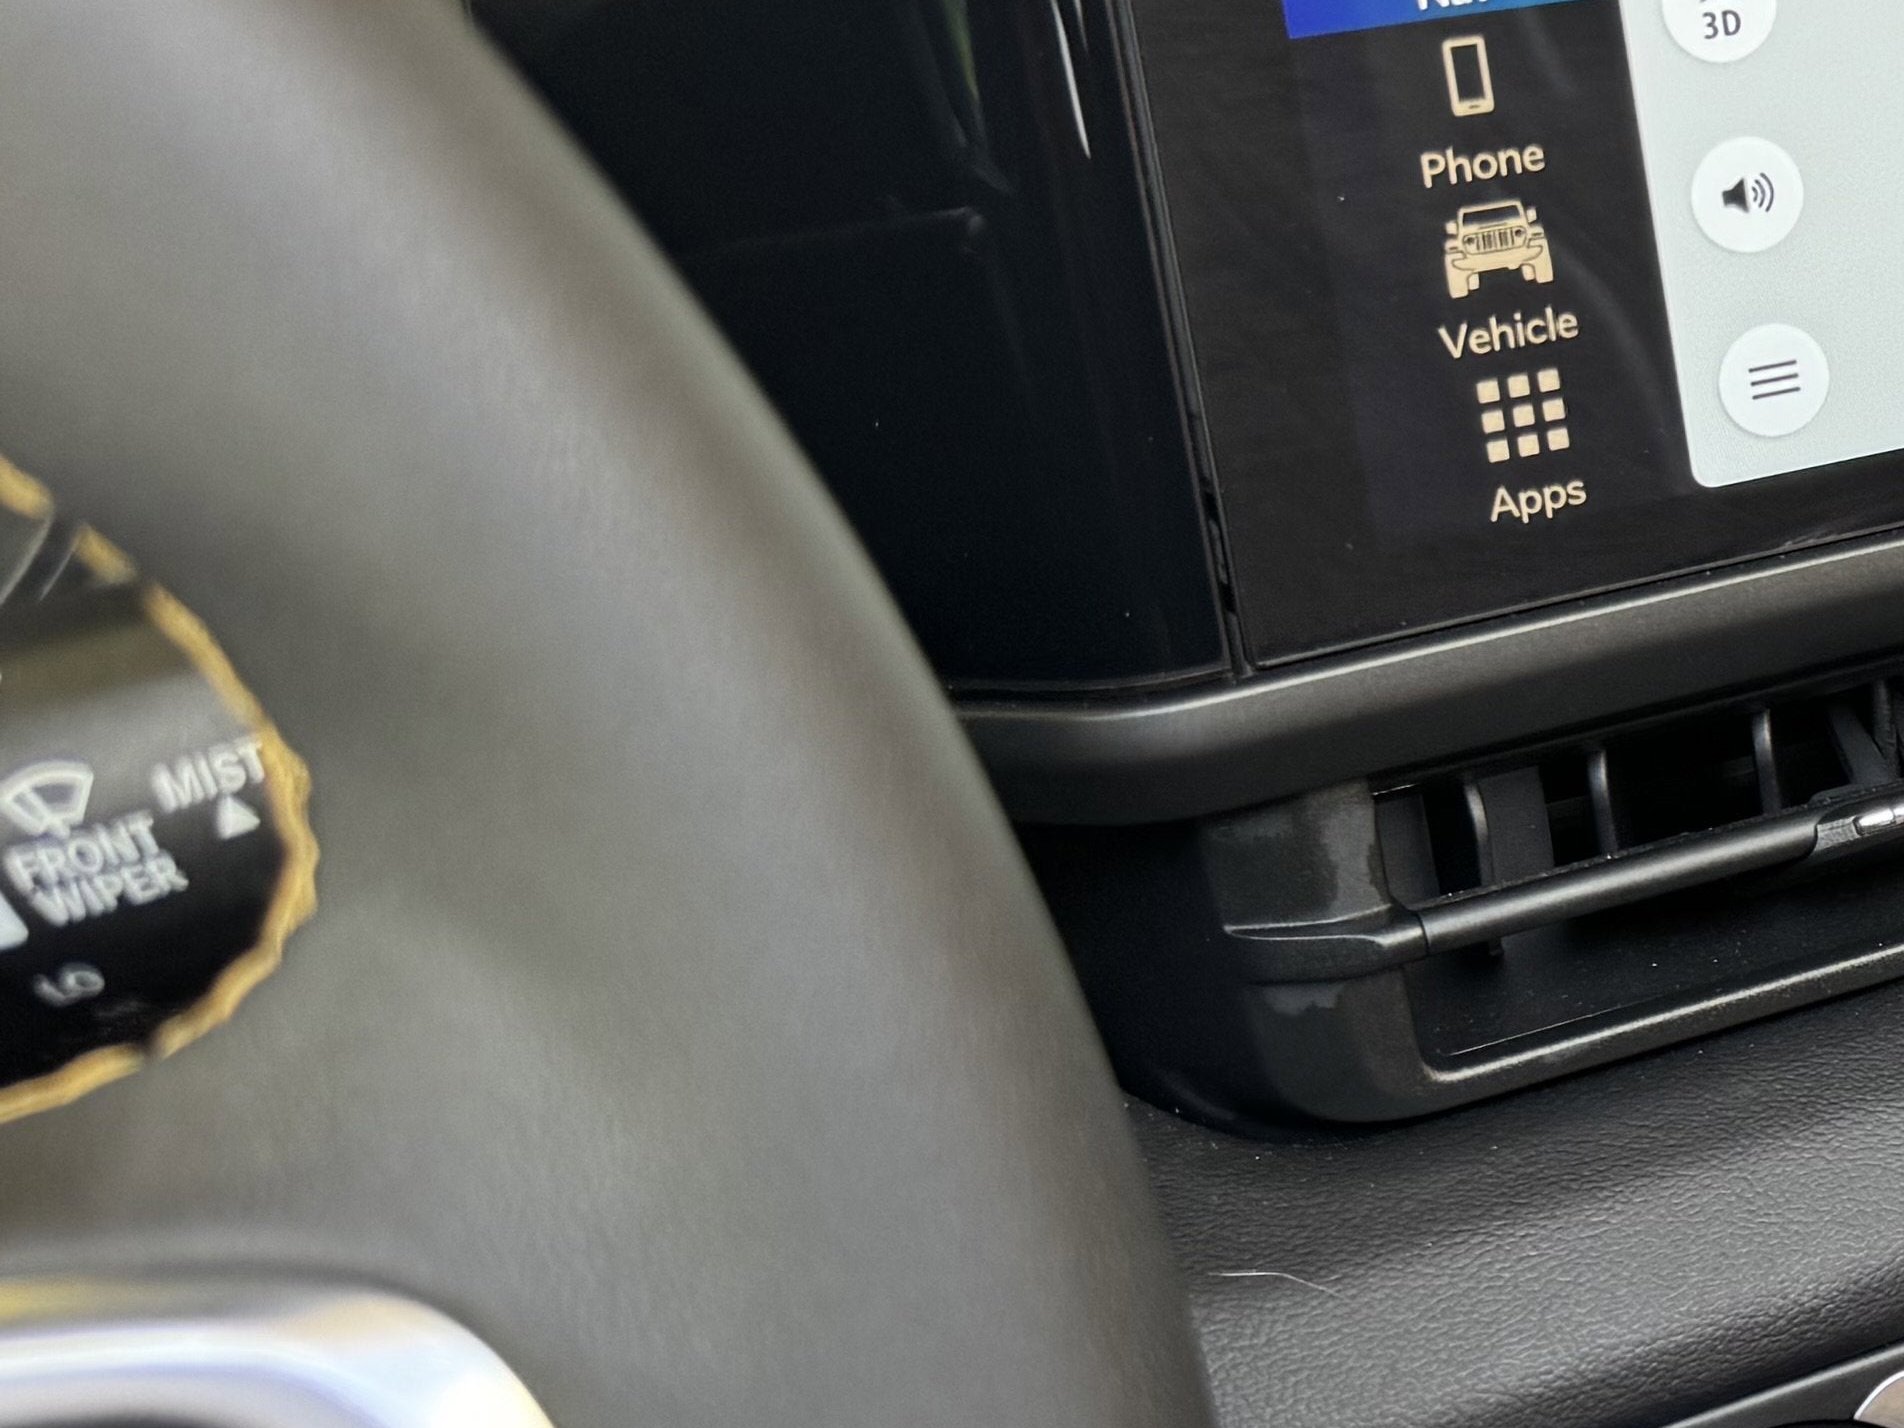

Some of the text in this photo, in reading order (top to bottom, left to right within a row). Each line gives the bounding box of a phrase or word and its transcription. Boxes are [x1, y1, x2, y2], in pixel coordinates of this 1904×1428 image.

[1701, 9, 1743, 41] 3D
[1420, 142, 1546, 188] Phone
[1437, 308, 1580, 360] Vehicle
[1489, 477, 1588, 522] Apps
[151, 733, 266, 813] MIST
[3, 809, 161, 887] FRONT
[31, 850, 189, 926] WIPER
